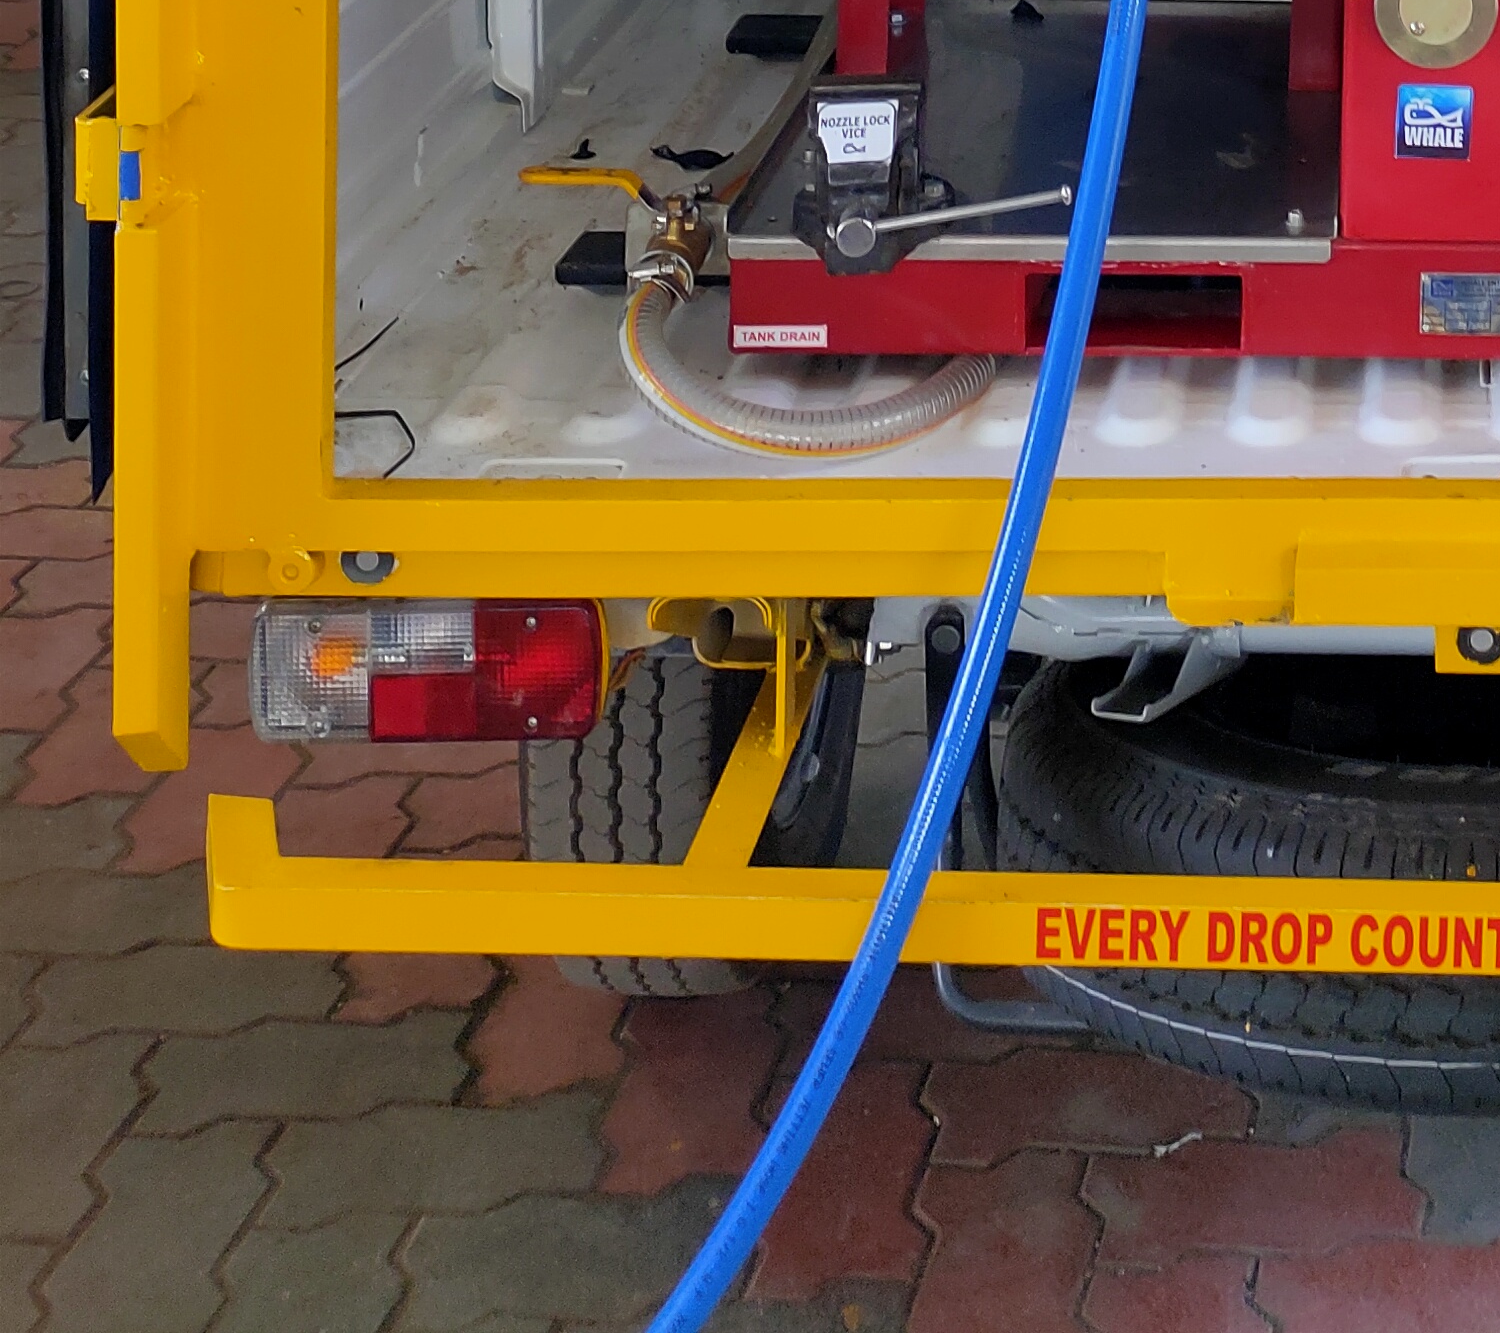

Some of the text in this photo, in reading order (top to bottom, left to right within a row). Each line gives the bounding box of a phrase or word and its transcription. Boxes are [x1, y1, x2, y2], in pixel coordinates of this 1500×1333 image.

[820, 115, 891, 128] NOZZLE LOCK
[842, 128, 866, 139] VICE
[1404, 125, 1464, 149] WHALE
[742, 331, 820, 342] TANK DRAIN
[1037, 907, 1190, 962] EVERY
[1207, 911, 1334, 965] DROP
